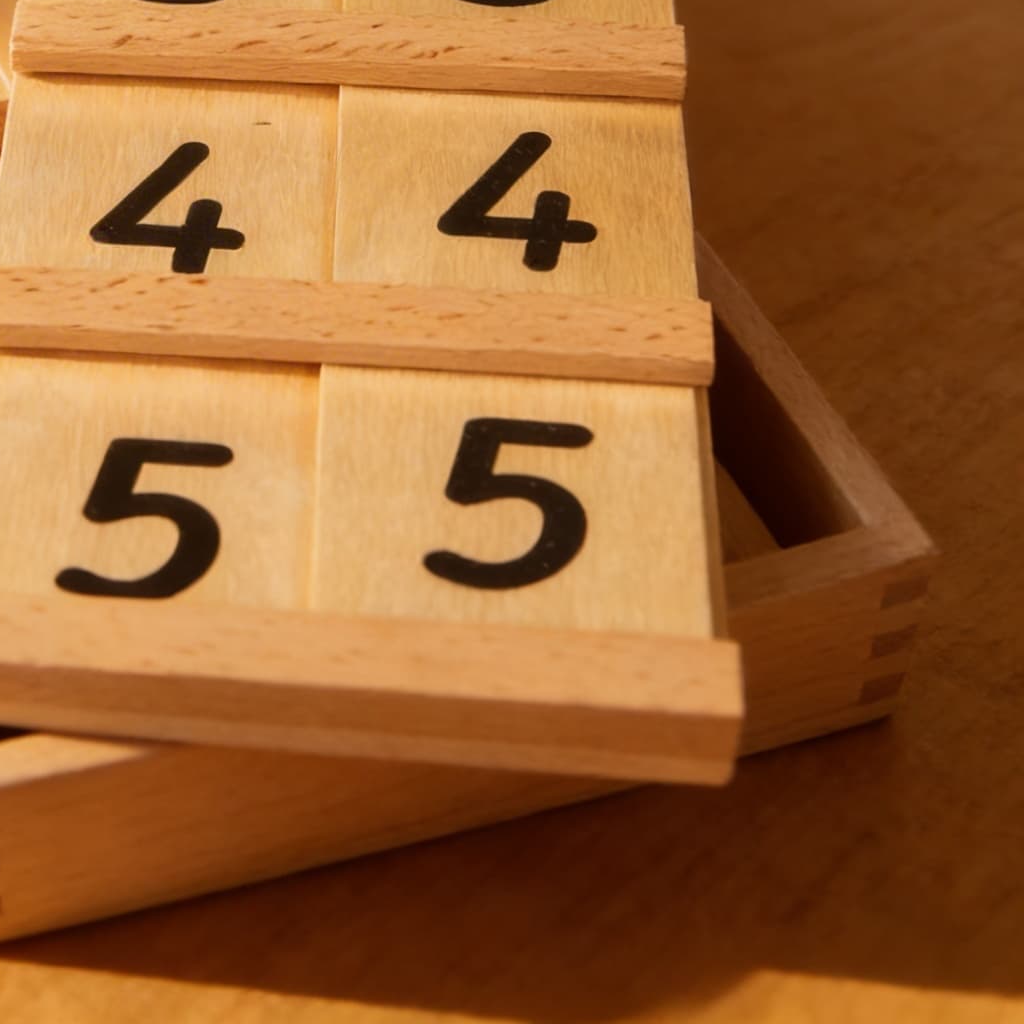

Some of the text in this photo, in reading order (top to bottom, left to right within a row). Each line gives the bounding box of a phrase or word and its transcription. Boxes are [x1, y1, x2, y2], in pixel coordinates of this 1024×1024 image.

[90, 131, 598, 274] 4 4
[55, 417, 594, 600] 5 5
